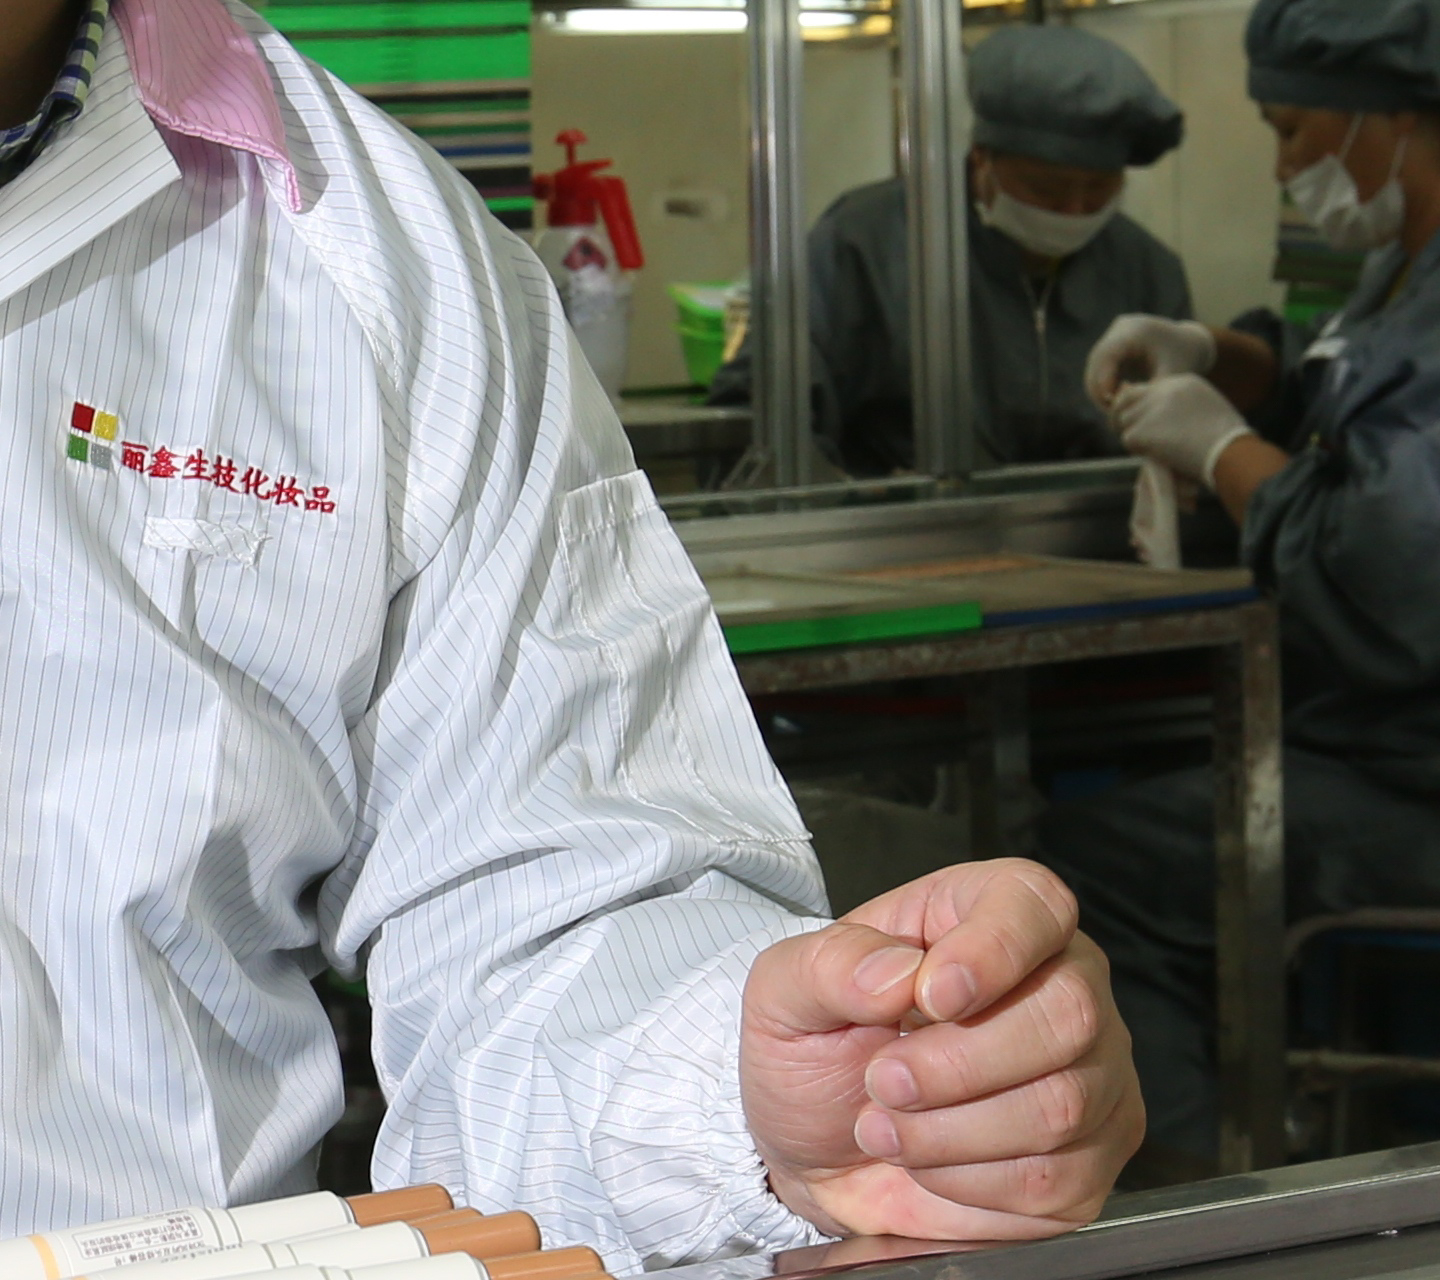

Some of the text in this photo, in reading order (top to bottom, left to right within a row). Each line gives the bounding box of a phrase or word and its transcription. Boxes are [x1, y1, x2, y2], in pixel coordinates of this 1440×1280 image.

[121, 440, 337, 514] 丽鑫生技化妆品
